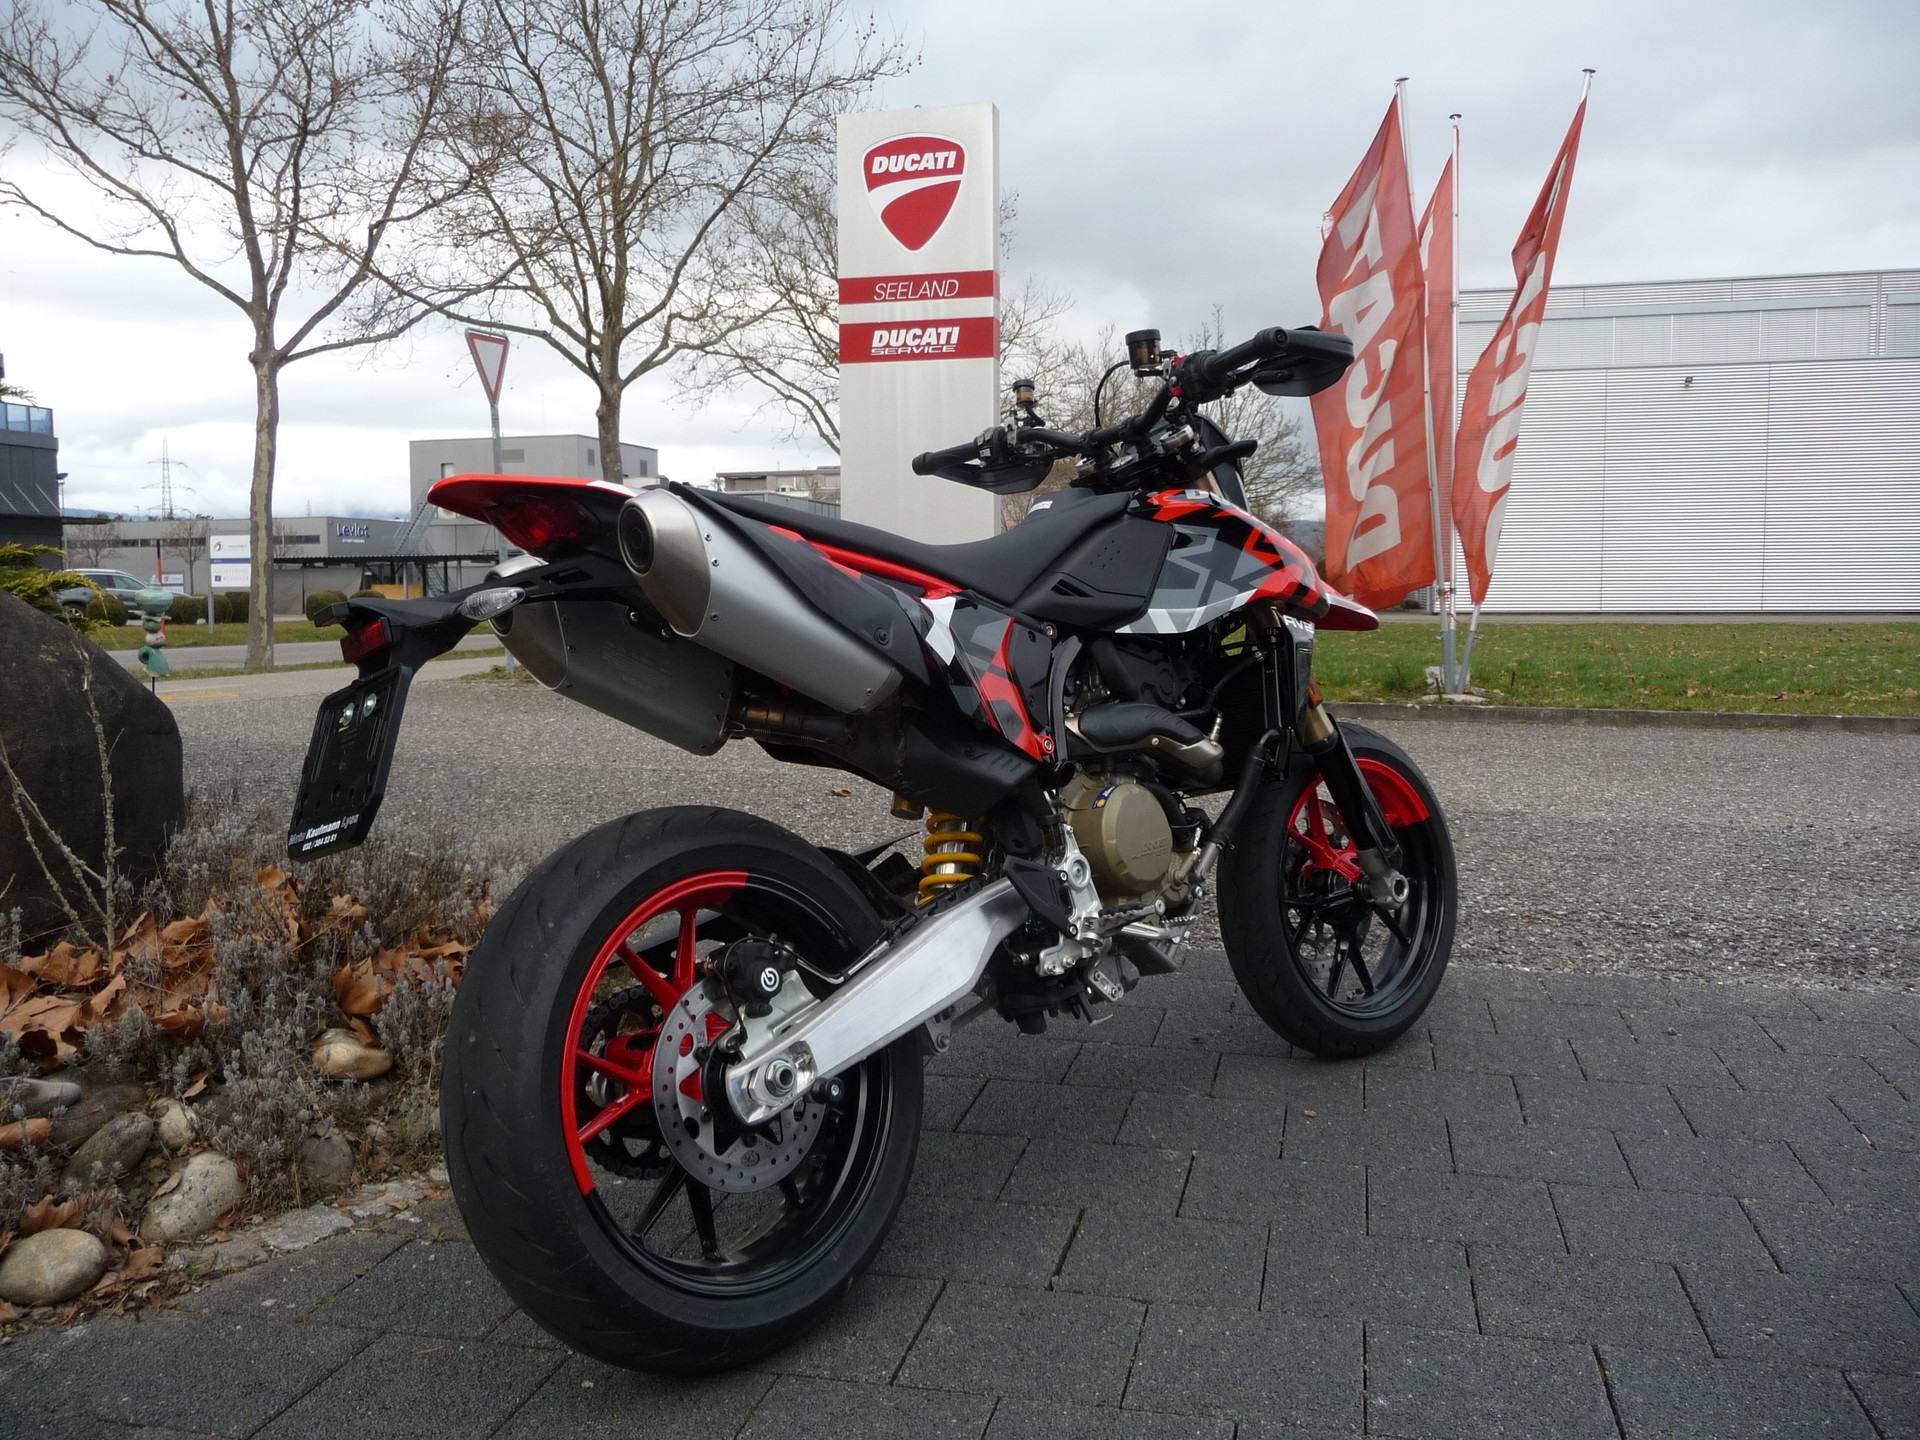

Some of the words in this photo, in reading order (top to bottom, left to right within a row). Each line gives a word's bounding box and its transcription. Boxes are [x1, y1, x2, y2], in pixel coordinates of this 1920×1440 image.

[871, 151, 957, 174] DUCATI
[873, 279, 959, 301] SEELAND
[871, 326, 960, 348] DUCATI
[871, 344, 956, 356] SERVICE
[305, 820, 341, 840] Kaufmann
